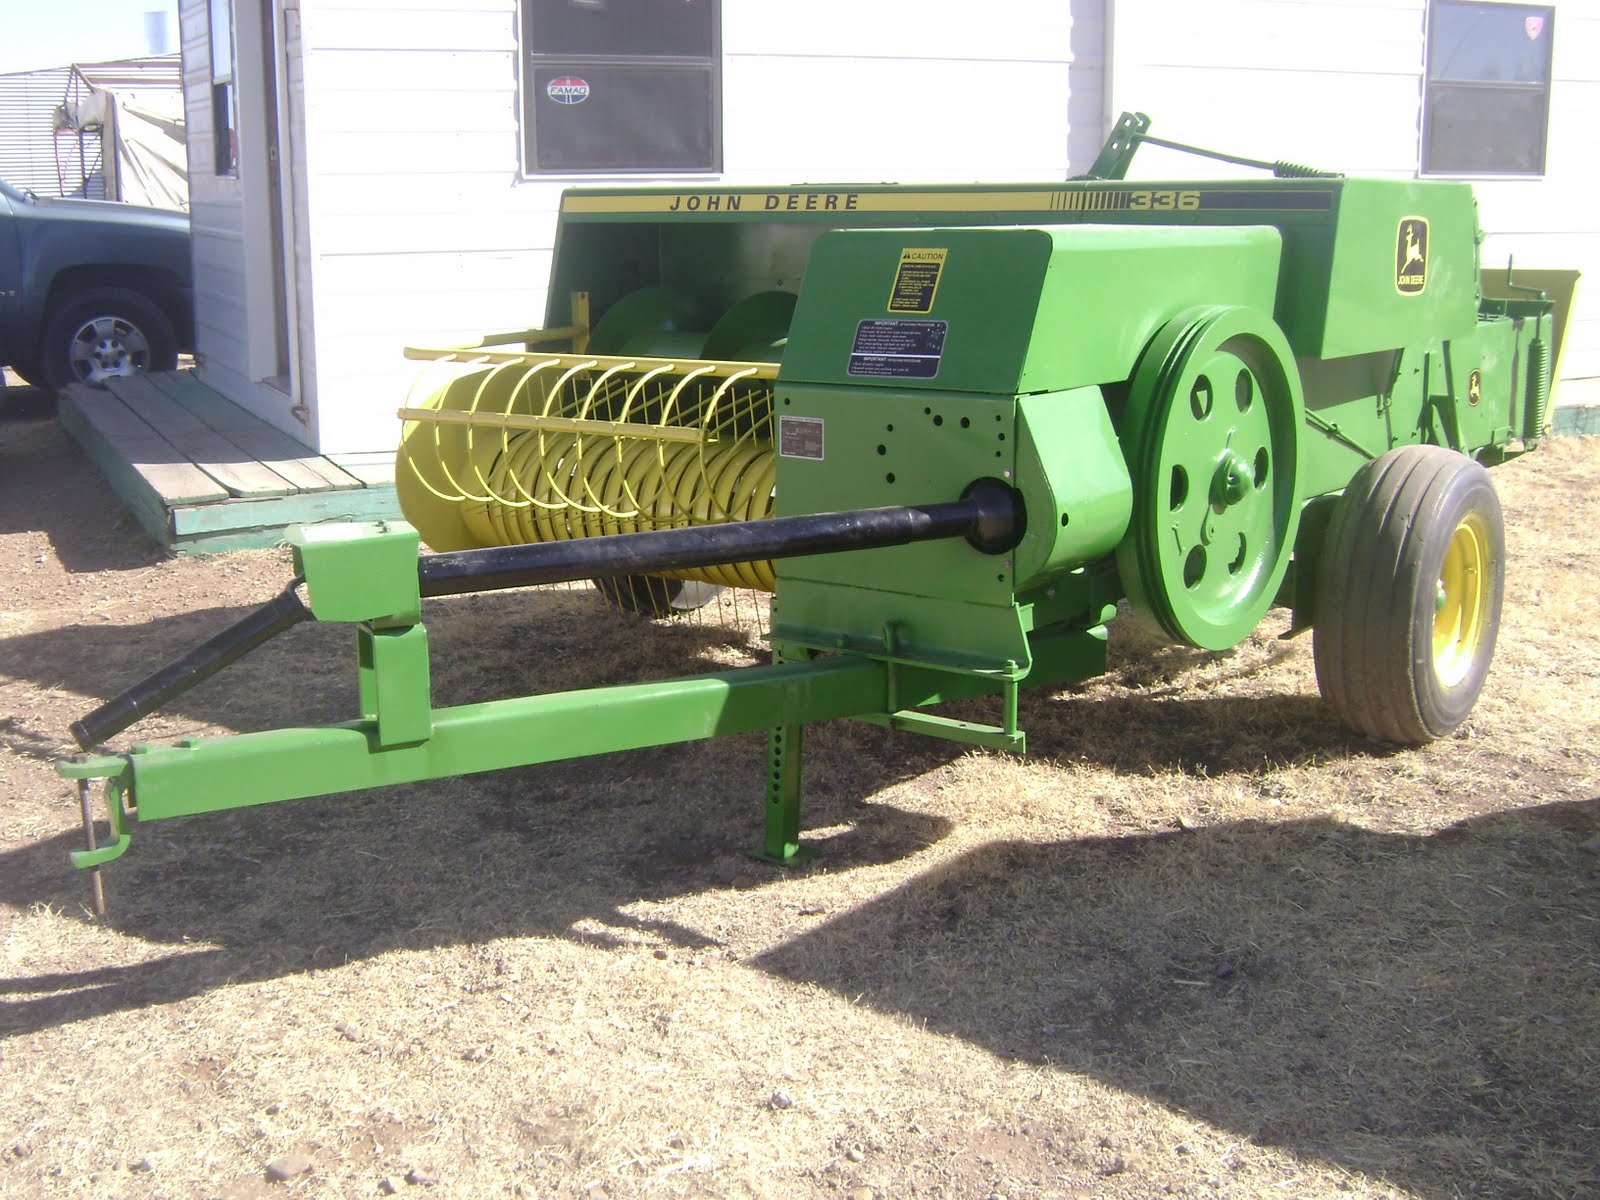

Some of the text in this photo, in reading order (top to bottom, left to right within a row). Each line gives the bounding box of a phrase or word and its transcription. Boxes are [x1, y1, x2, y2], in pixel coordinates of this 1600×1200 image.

[669, 194, 858, 211] JOHN DEERE
[1130, 190, 1200, 210] 336
[911, 252, 944, 260] CAUTION
[1398, 274, 1424, 285] JOHN DEERE
